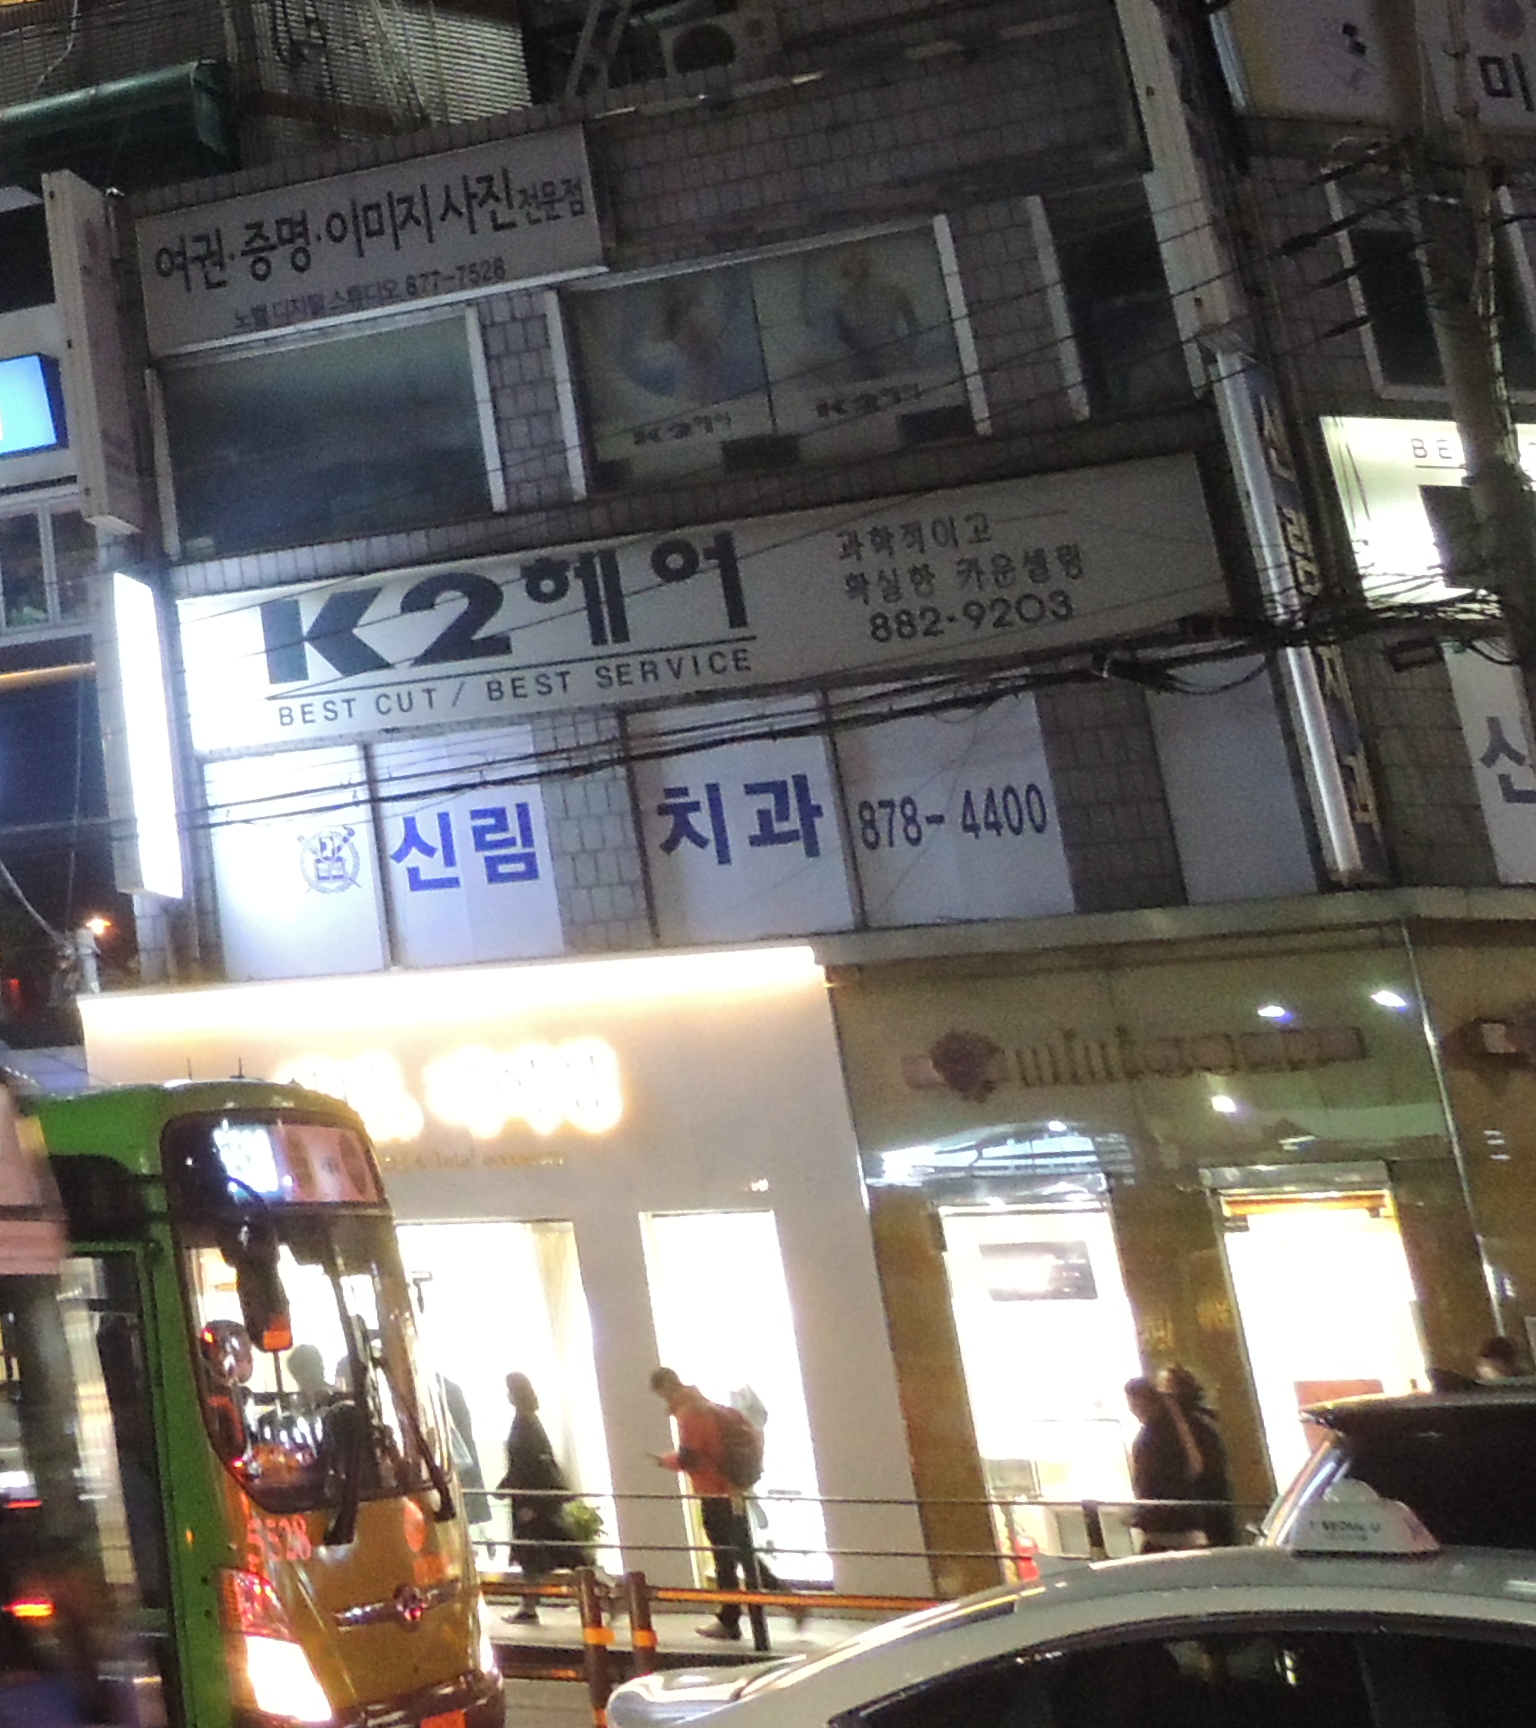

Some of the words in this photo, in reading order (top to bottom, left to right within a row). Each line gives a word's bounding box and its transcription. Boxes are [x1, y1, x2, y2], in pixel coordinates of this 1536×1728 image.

[835, 511, 993, 562] 과학적이고
[264, 530, 750, 687] K2헤어
[278, 700, 359, 728] BEST
[485, 668, 570, 704] BEST
[596, 647, 753, 690] SERVICE
[387, 799, 542, 896] 신림
[656, 771, 824, 868] 치과
[246, 1513, 313, 1566] 5528
